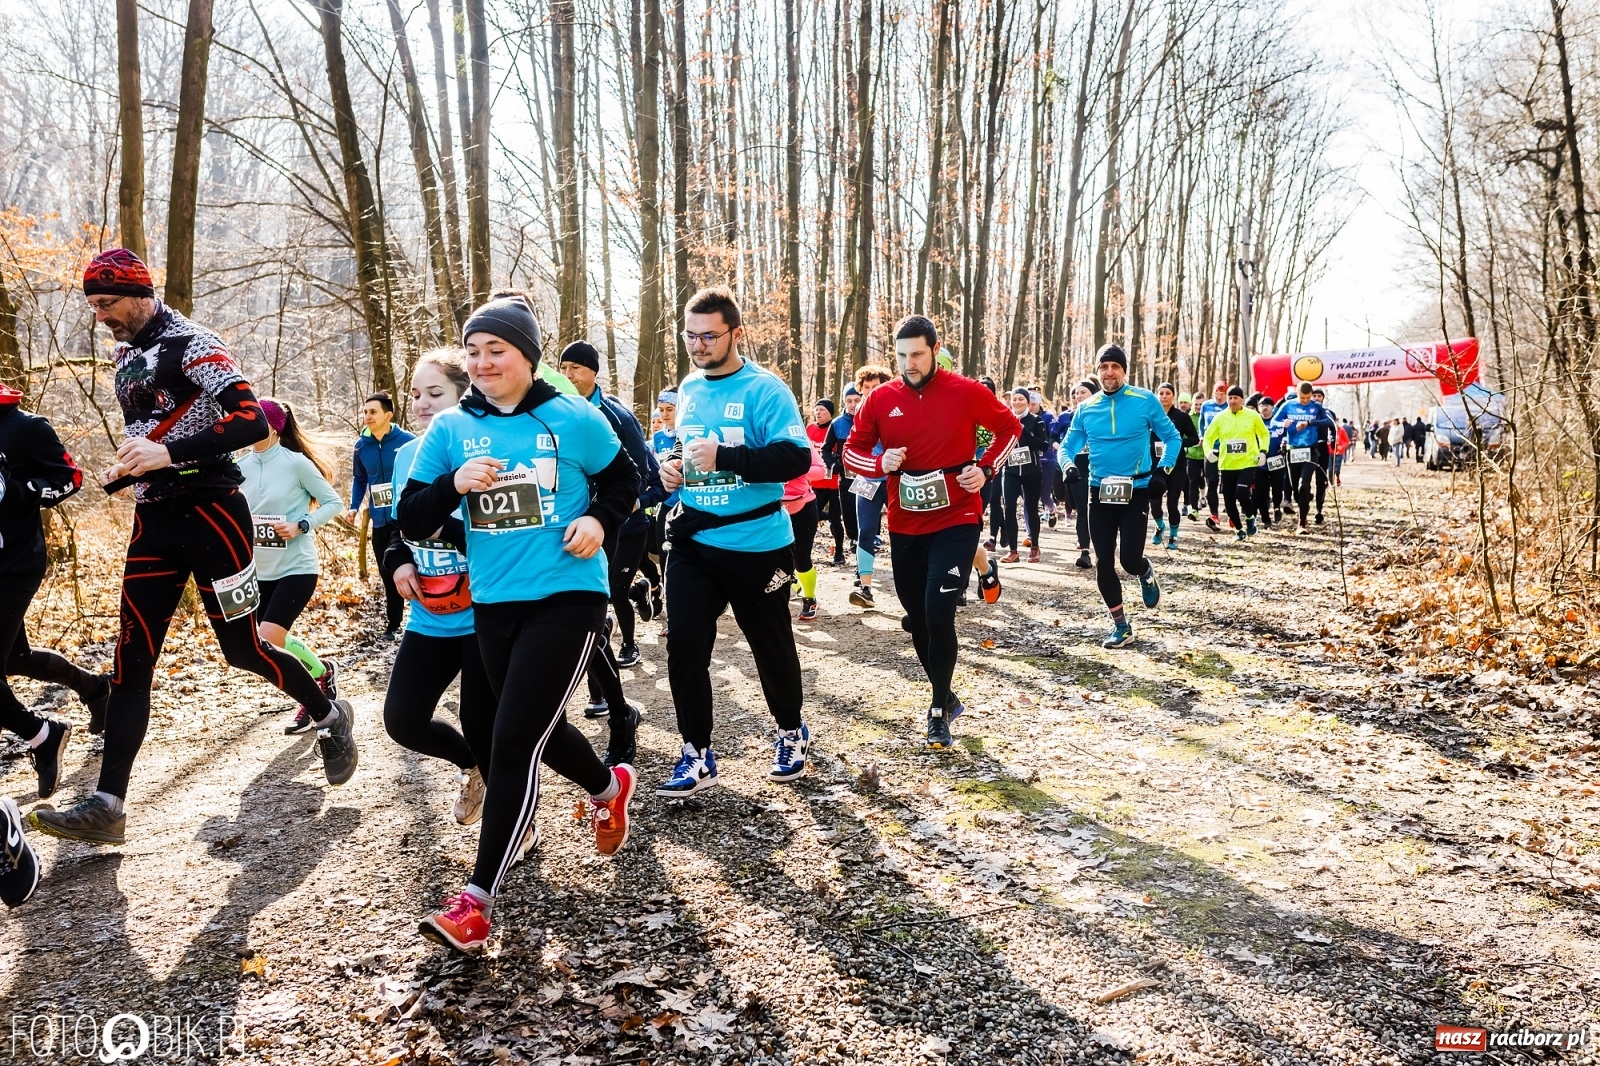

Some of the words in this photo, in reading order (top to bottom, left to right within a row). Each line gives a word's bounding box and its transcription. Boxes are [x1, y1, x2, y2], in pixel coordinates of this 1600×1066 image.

[1350, 351, 1375, 359] BIEG
[1330, 359, 1396, 370] TWARDZIELA
[1337, 370, 1389, 380] RACIBÓRZ
[728, 405, 742, 417] TBI
[463, 436, 491, 451] DLO
[1231, 443, 1242, 451] 127
[1011, 453, 1026, 461] 054
[497, 473, 526, 482] ardziela
[856, 481, 873, 492] 042
[1105, 484, 1125, 496] 071
[378, 490, 393, 501] 119
[905, 485, 937, 502] 083
[479, 491, 520, 515] 021
[695, 494, 730, 506] 2022
[231, 575, 259, 604] 036
